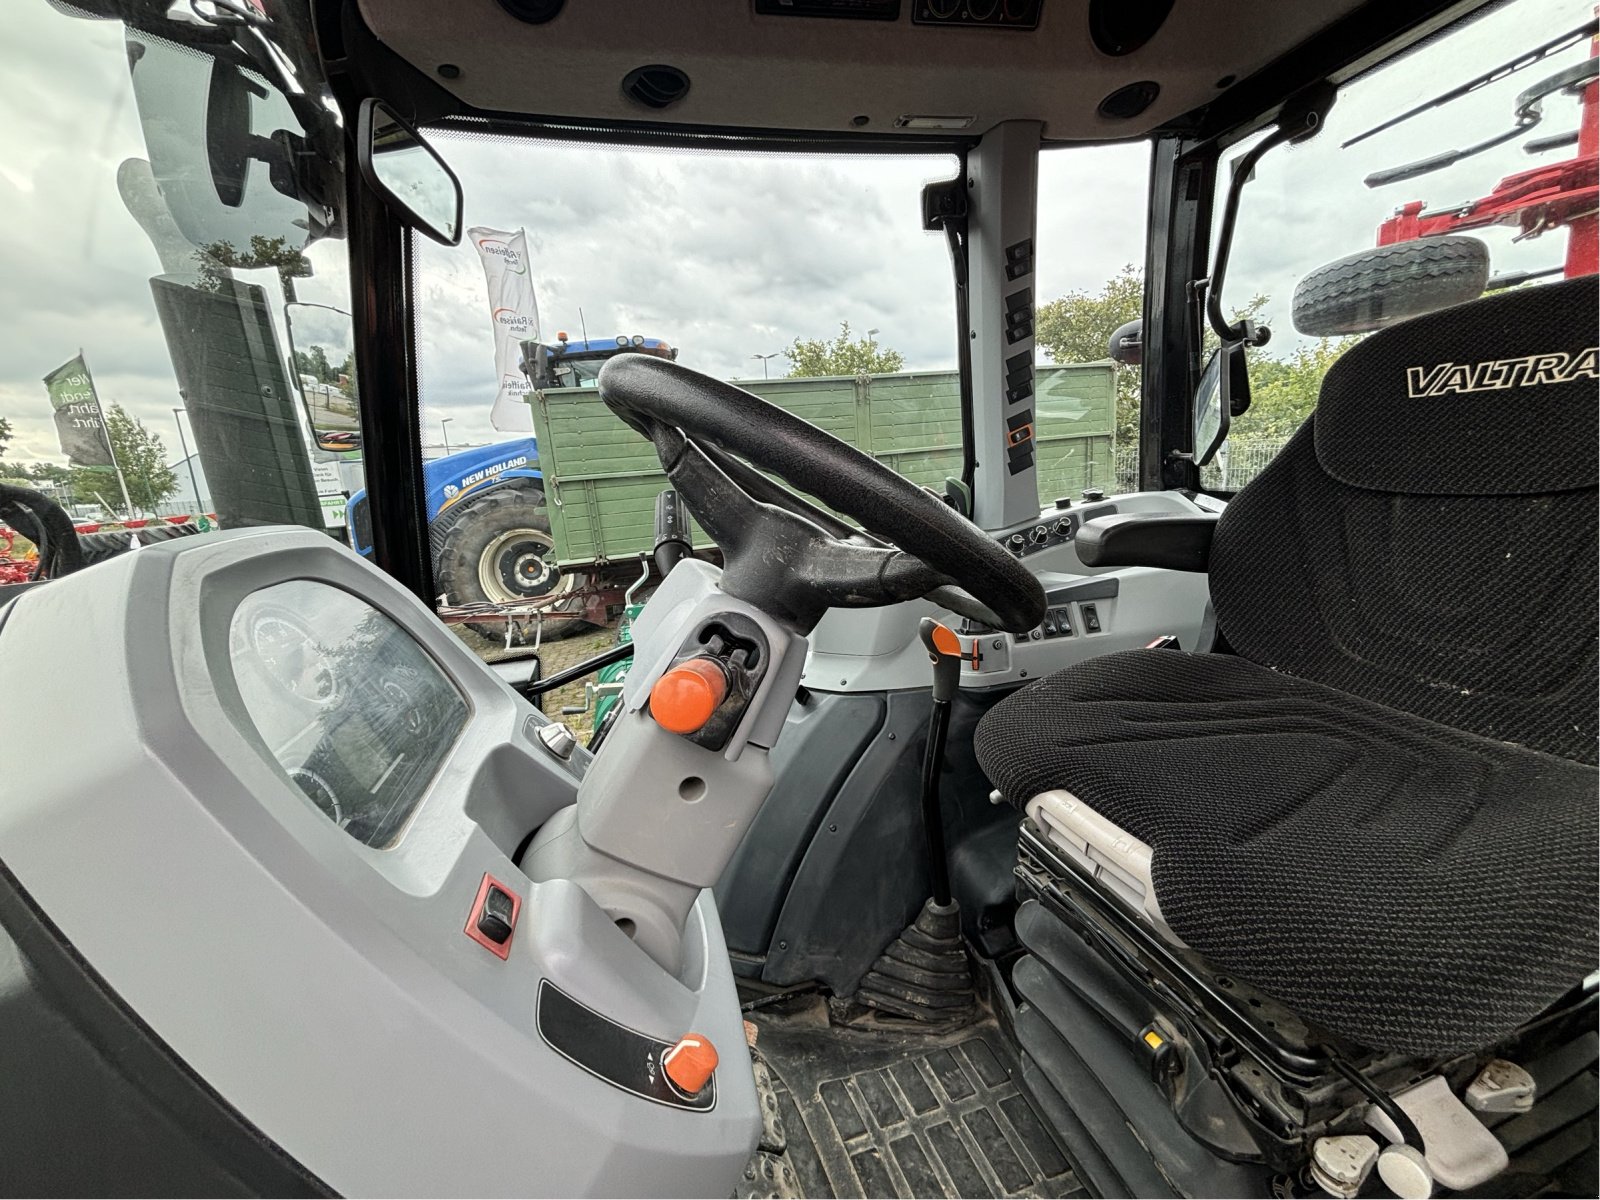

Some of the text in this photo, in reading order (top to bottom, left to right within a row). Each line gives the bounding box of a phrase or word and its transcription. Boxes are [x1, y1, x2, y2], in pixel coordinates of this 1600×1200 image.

[1406, 347, 1600, 398] VALTRA
[461, 456, 527, 488] NEW HOLLAND
